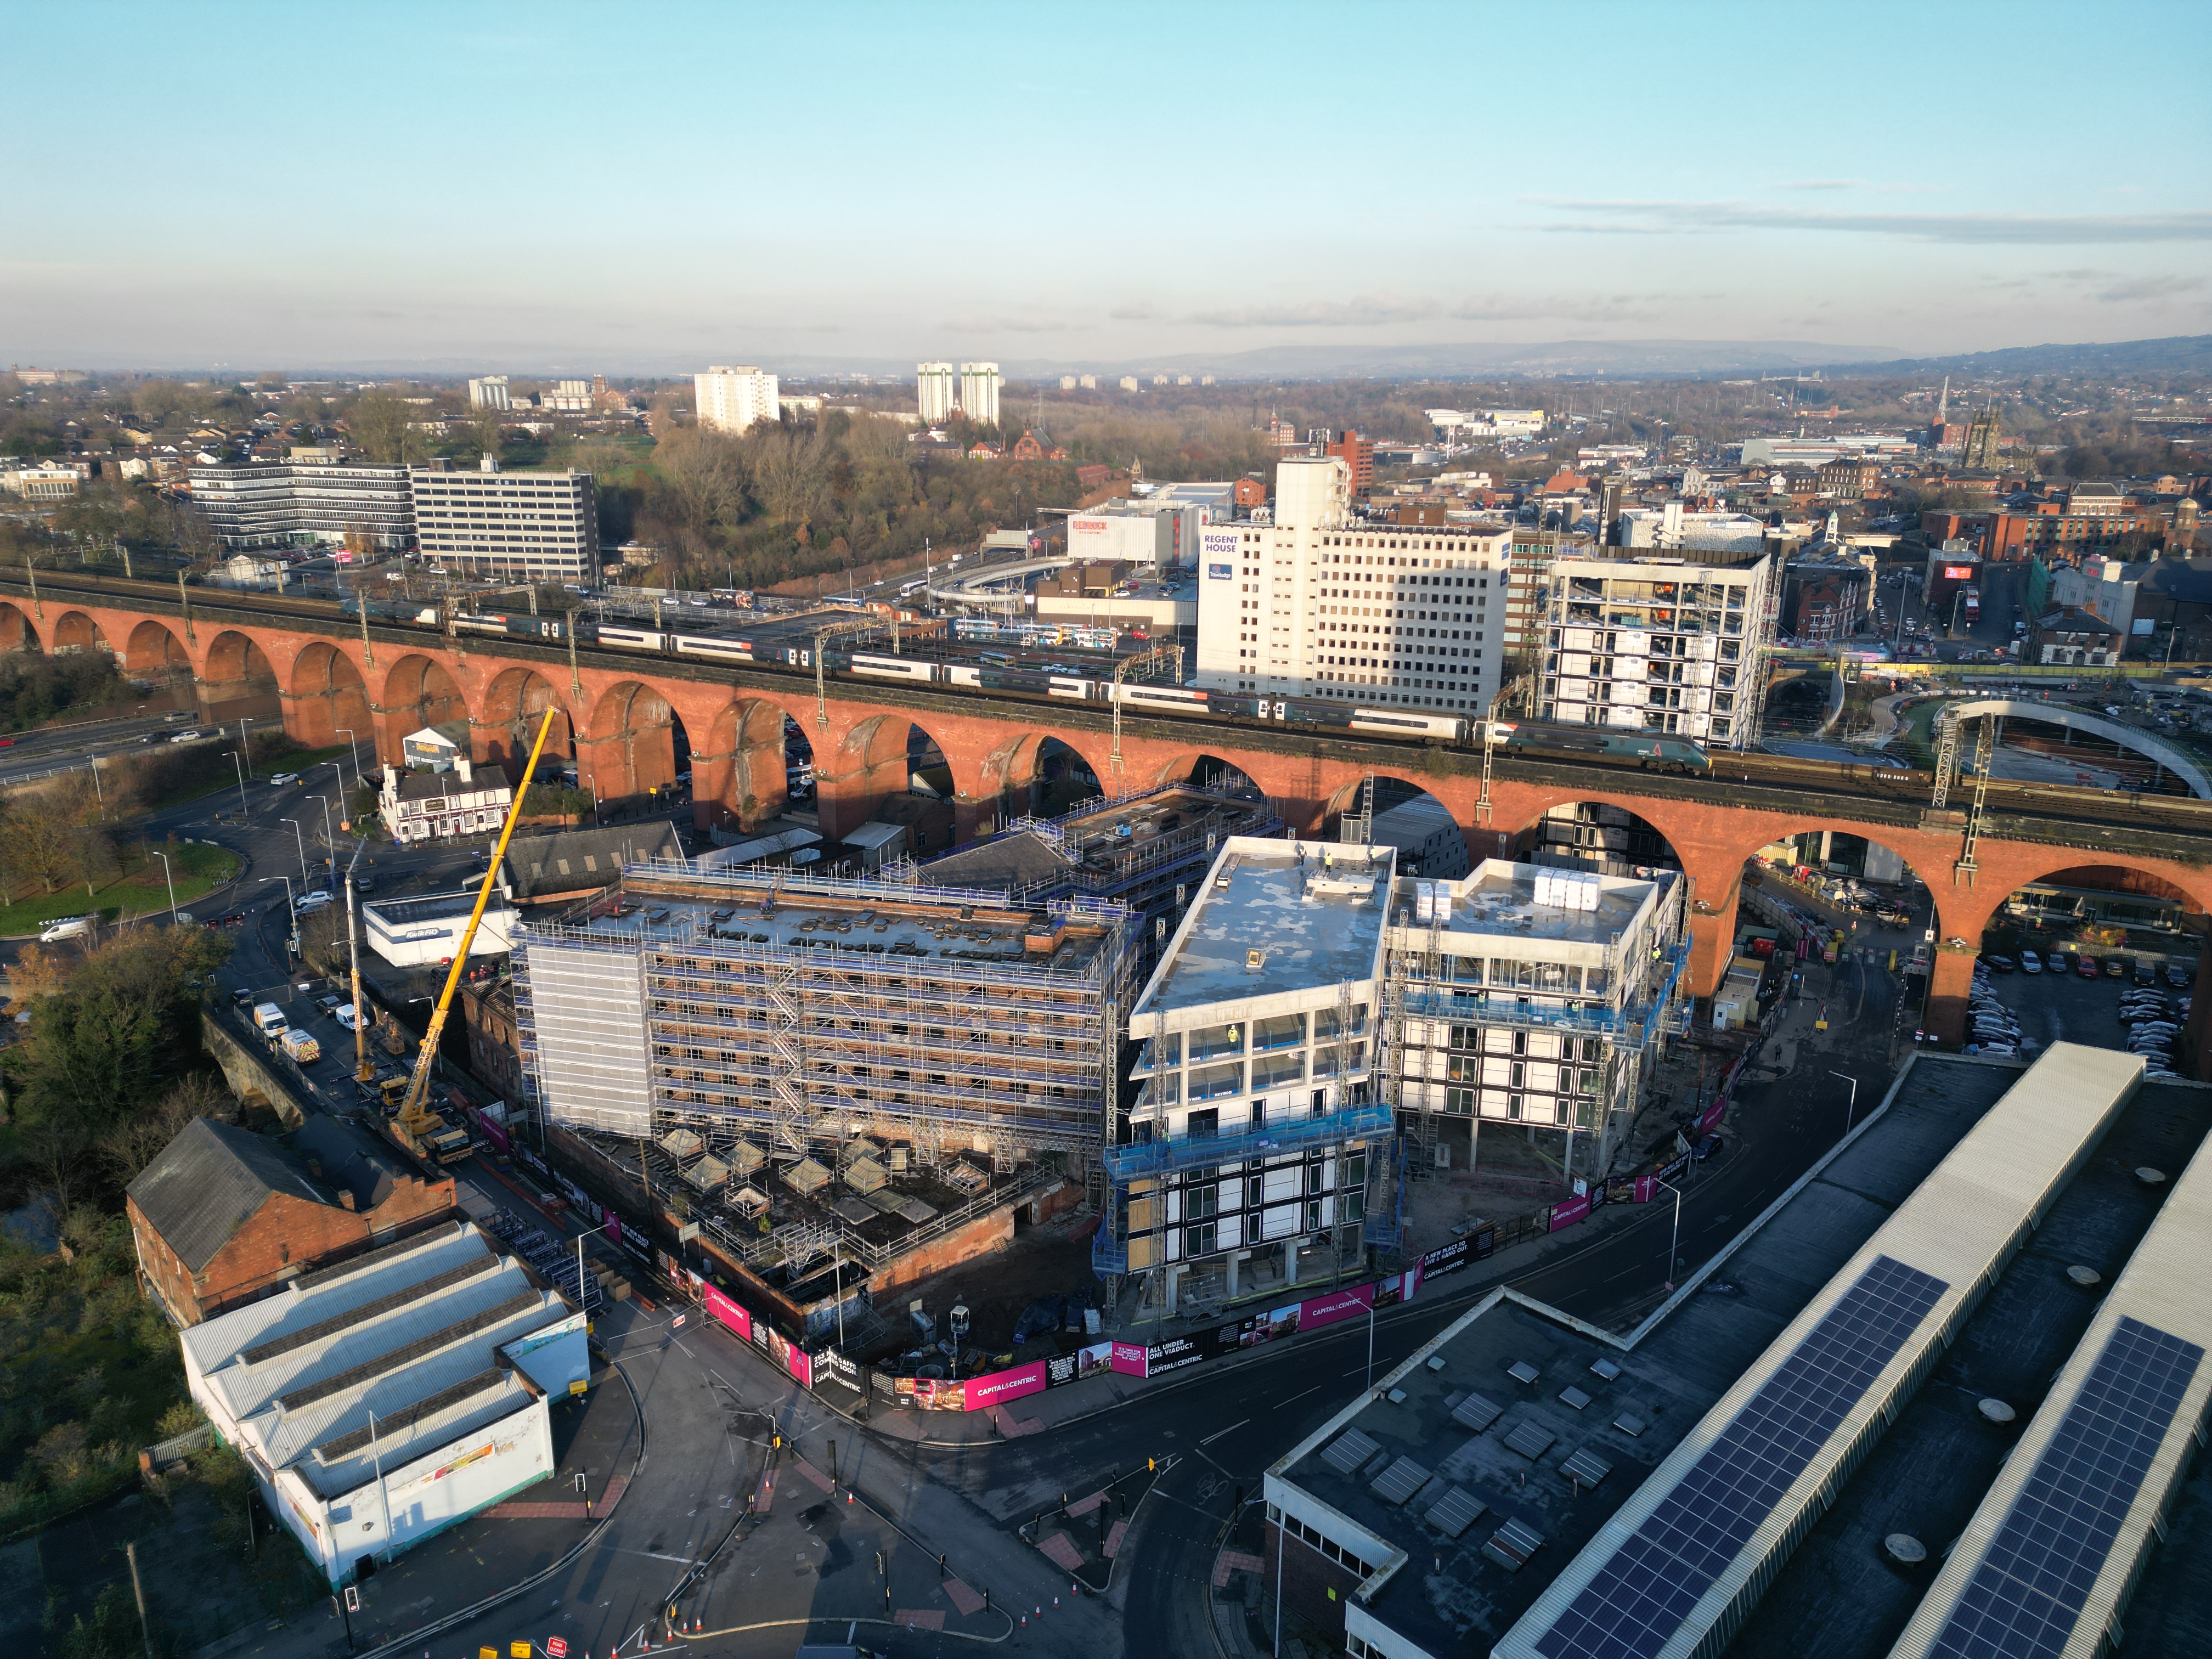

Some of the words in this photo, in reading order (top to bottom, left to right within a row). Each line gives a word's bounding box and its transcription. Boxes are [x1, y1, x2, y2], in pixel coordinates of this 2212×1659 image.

[1205, 535, 1238, 543] REGENT
[1206, 544, 1236, 552] HOUSE
[424, 1029, 439, 1068] AINSCOUGH
[404, 1037, 430, 1101] AINSCOUGH
[1554, 1201, 1588, 1221] CAPITAL&CENTRIC
[1425, 1258, 1435, 1266] LIVE
[1441, 1249, 1456, 1260] HANG
[1430, 1250, 1442, 1259] NEW
[1442, 1243, 1458, 1254] PLACE
[1424, 1259, 1465, 1279] CAPITAL&CENTRIC
[711, 1292, 744, 1320] CAPITAL&CENTRIC
[1312, 1297, 1361, 1316] CAPITAL&CENTRIC
[1149, 1346, 1161, 1354] ALL
[1163, 1339, 1184, 1350] UNDER
[1149, 1351, 1163, 1359] ONE
[1164, 1342, 1195, 1355] VIADUCT.
[814, 1352, 825, 1362] 253
[826, 1350, 838, 1361] NEW
[838, 1357, 856, 1370] GAFFS
[839, 1363, 858, 1376] SOON.
[1149, 1354, 1203, 1375] CAPITAL&CENTRIC
[815, 1371, 861, 1392] CAPITAL&CENTRIC
[977, 1375, 1037, 1396] CAPITAL&CENTRIC
